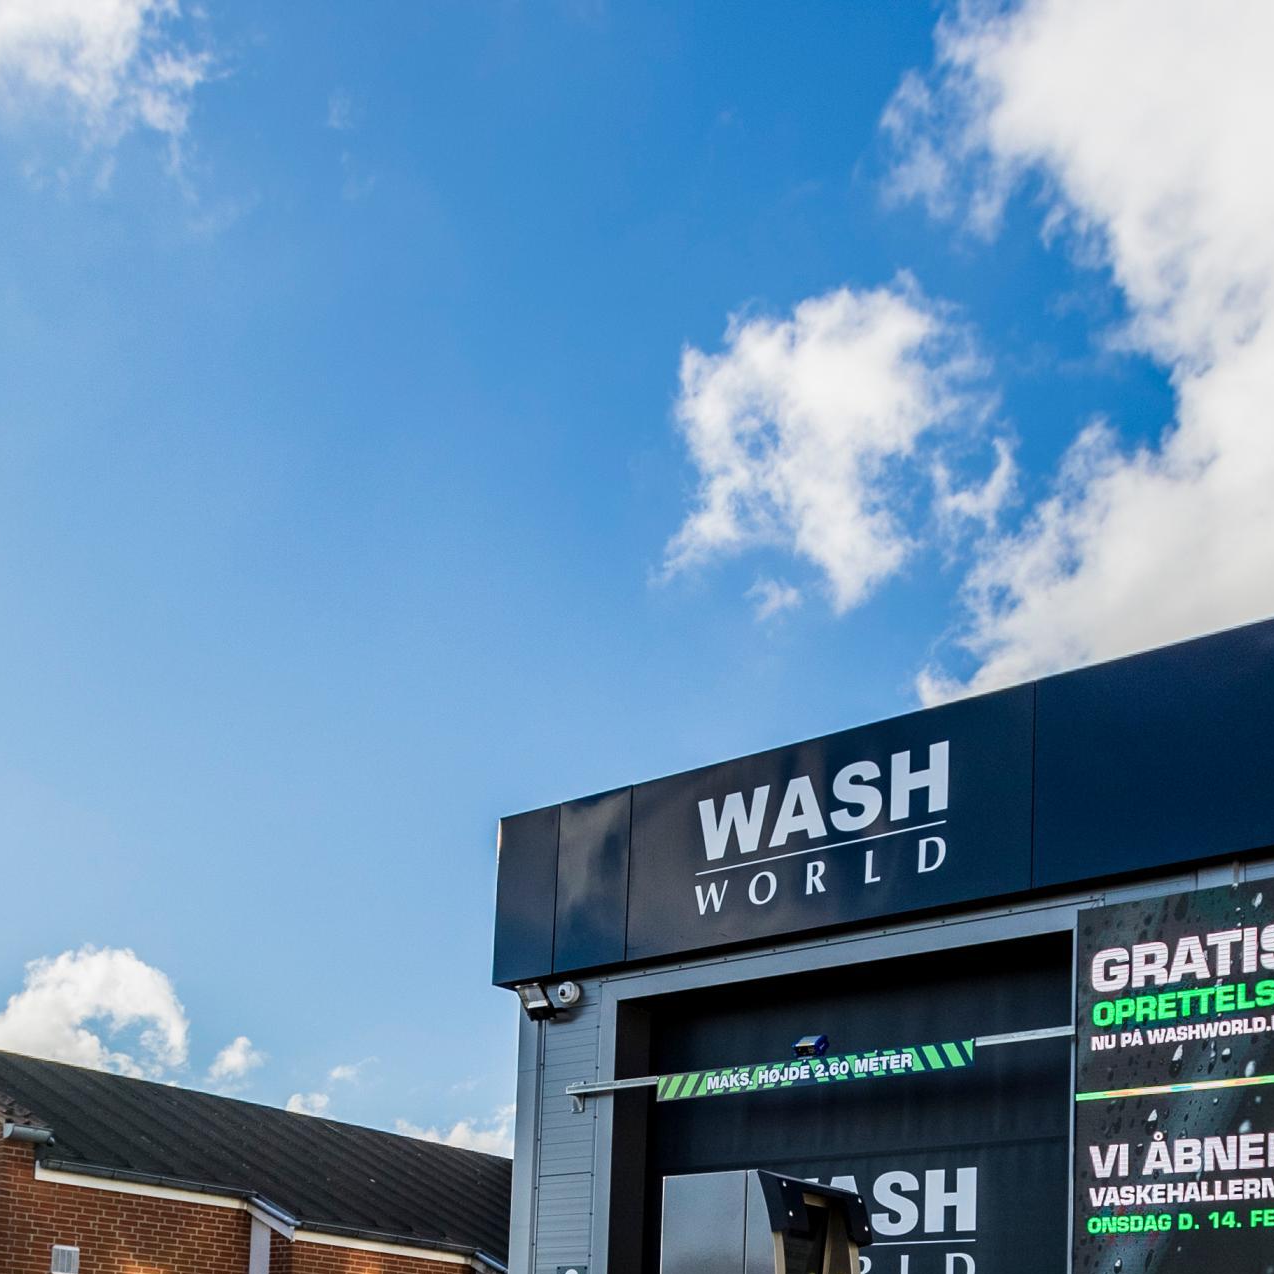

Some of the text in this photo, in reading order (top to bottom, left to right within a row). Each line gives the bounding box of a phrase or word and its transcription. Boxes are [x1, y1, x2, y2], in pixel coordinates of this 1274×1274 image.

[697, 739, 950, 861] WASH
[694, 836, 948, 916] WORLD
[1090, 1032, 1117, 1052] NU
[1120, 1026, 1145, 1047] PÅ
[706, 1053, 913, 1090] MAKS. HØJDE 2.60 METER
[1089, 1143, 1129, 1179] VI
[804, 1166, 978, 1236] SH
[1087, 1213, 1172, 1235] ONSDAG
[1178, 1212, 1200, 1231] D.
[1208, 1210, 1243, 1230] 14.
